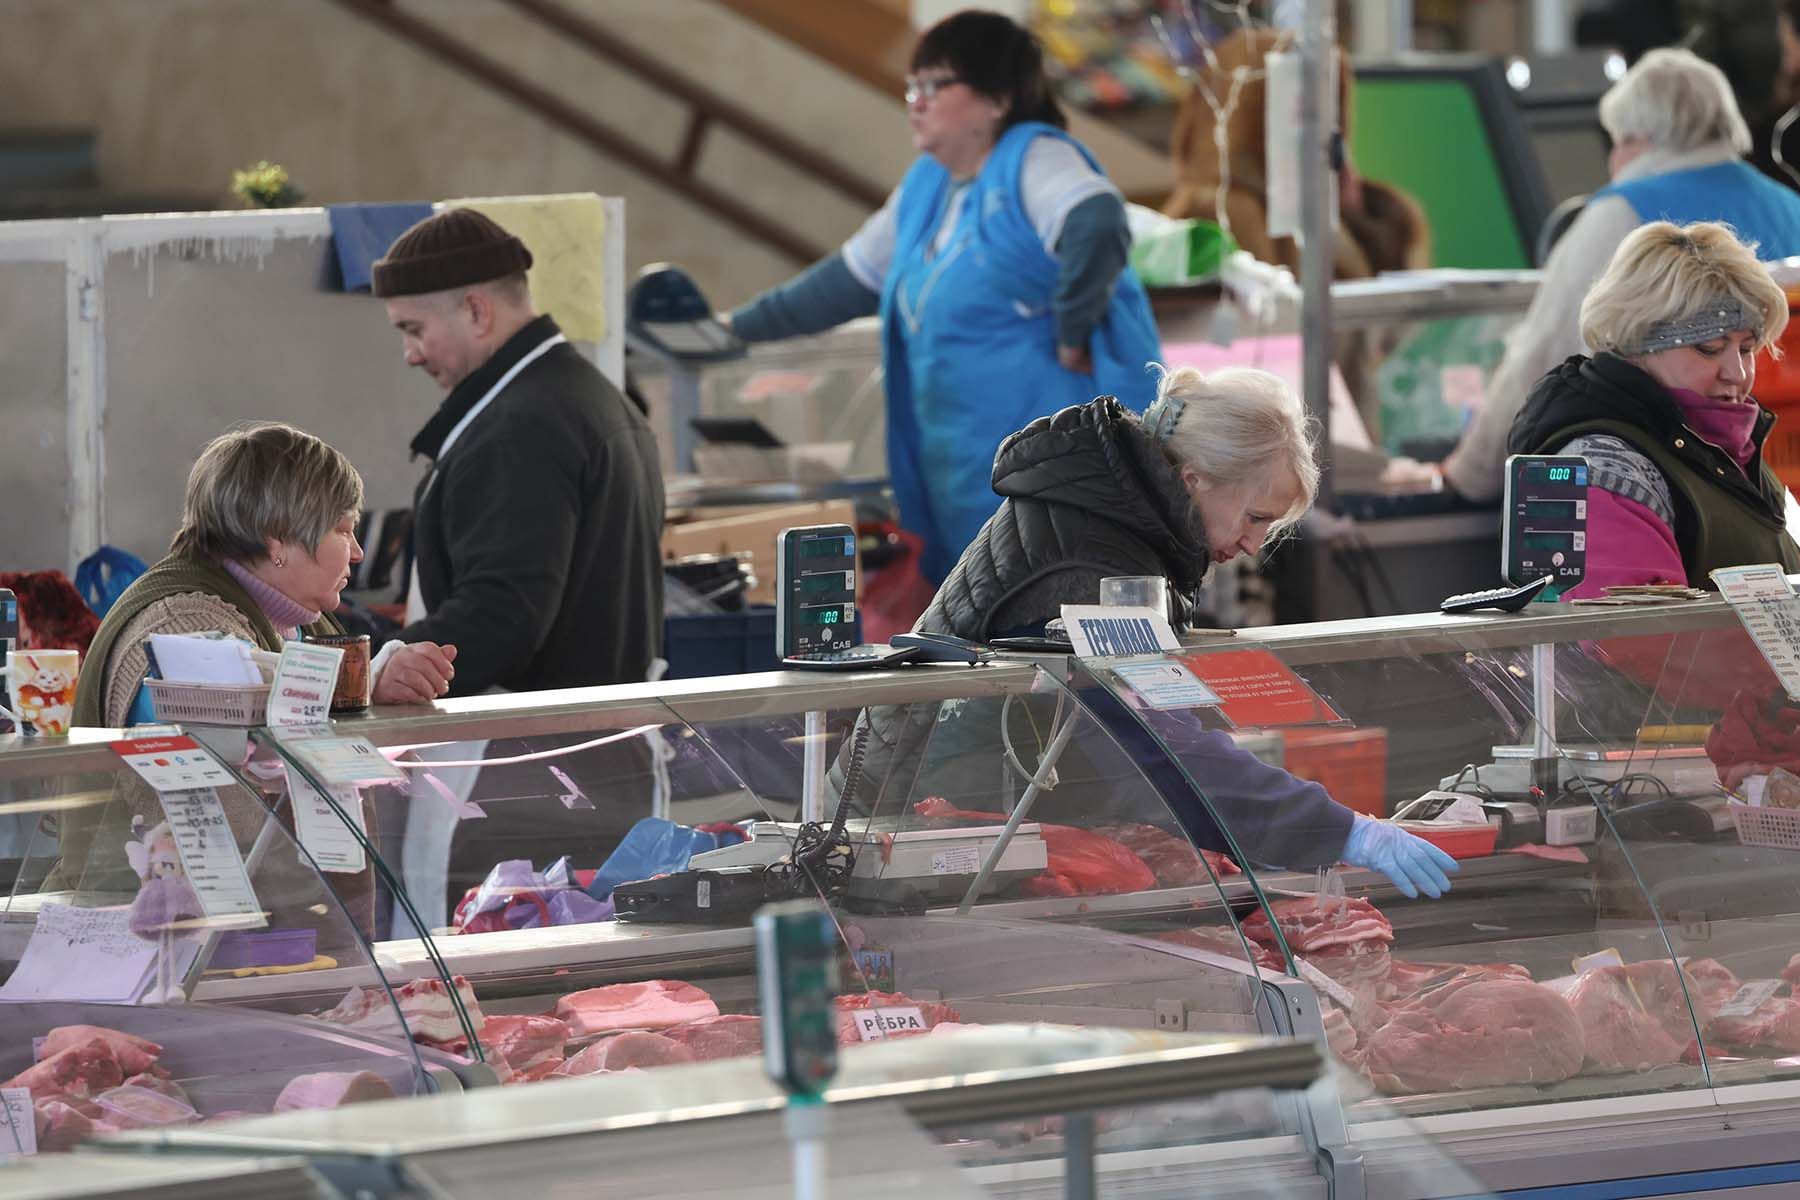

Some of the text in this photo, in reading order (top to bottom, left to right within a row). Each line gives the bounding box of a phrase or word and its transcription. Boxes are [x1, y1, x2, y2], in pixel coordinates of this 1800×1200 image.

[1560, 567, 1580, 576] CAS
[1078, 618, 1162, 657] ТЕРМИНАЛ
[832, 640, 851, 650] CAS
